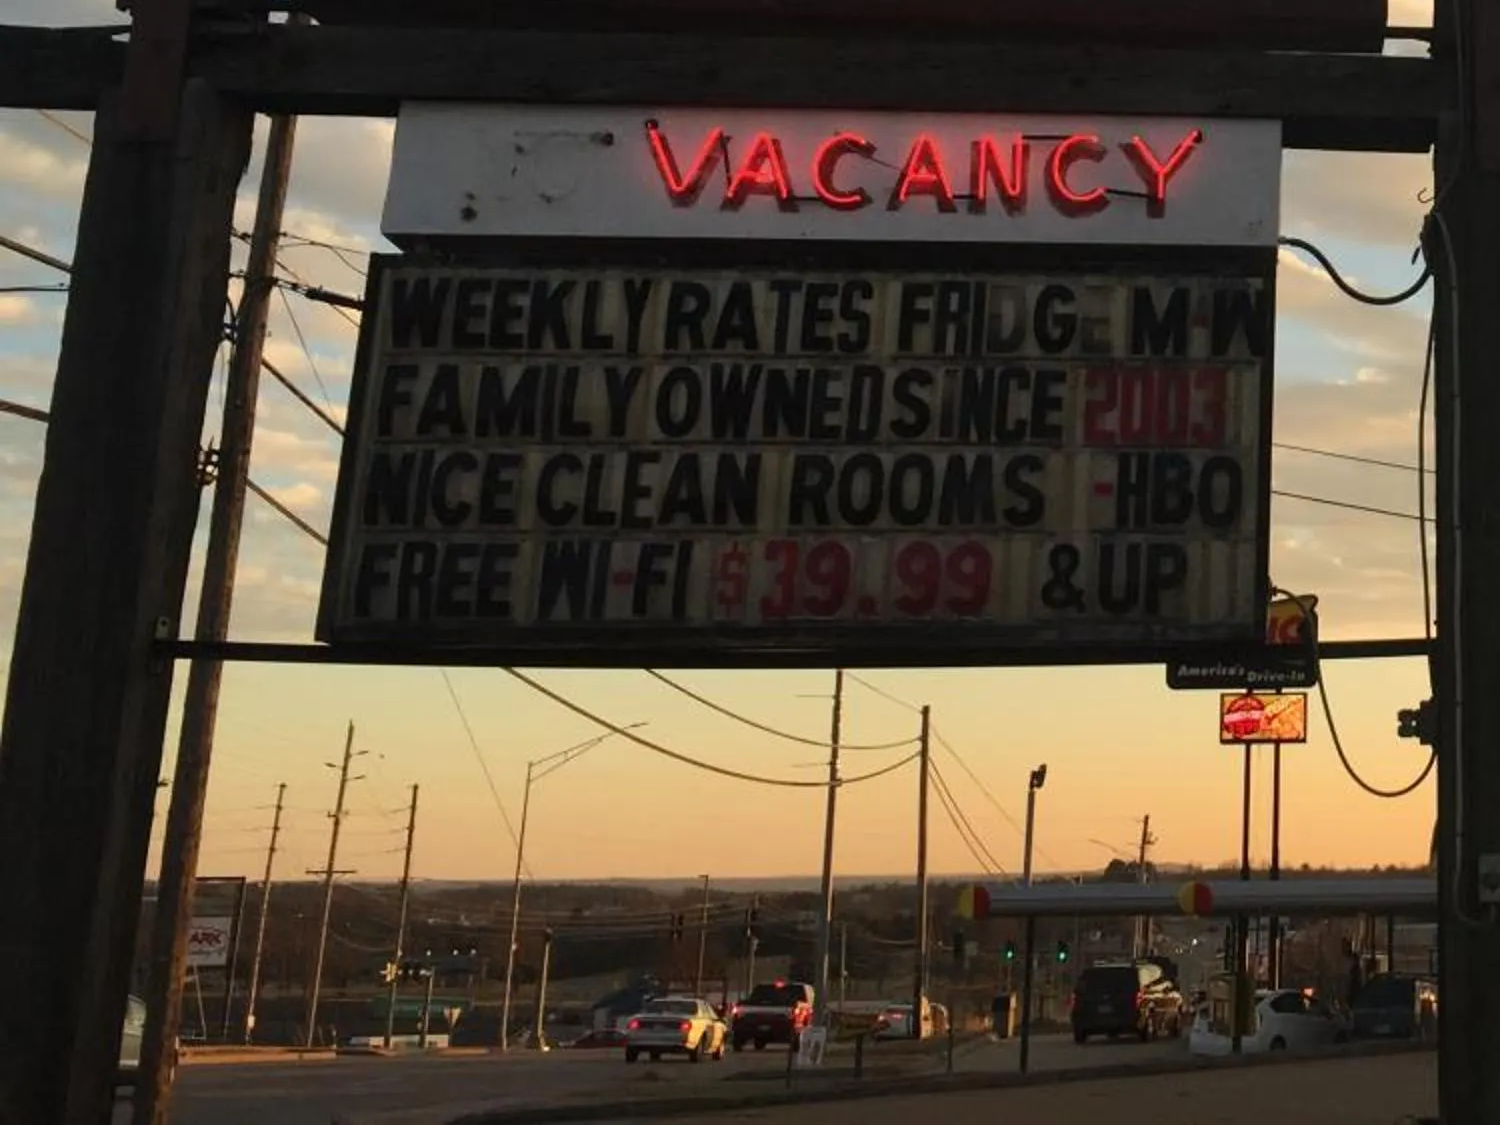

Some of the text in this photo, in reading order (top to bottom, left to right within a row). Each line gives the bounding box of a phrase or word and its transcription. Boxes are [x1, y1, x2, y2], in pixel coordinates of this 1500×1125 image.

[645, 122, 1203, 215] VACANCY
[391, 278, 653, 354] WEEKLY
[664, 280, 874, 354] RATES
[377, 363, 1228, 447] FAMILY OWNED SINCE 2003
[362, 450, 524, 527] NICE
[536, 451, 763, 529] CLEAN
[789, 452, 1046, 528] ROOMS
[354, 541, 521, 619] FREE
[538, 538, 697, 621] WI-FI
[715, 539, 994, 618] $39.99
